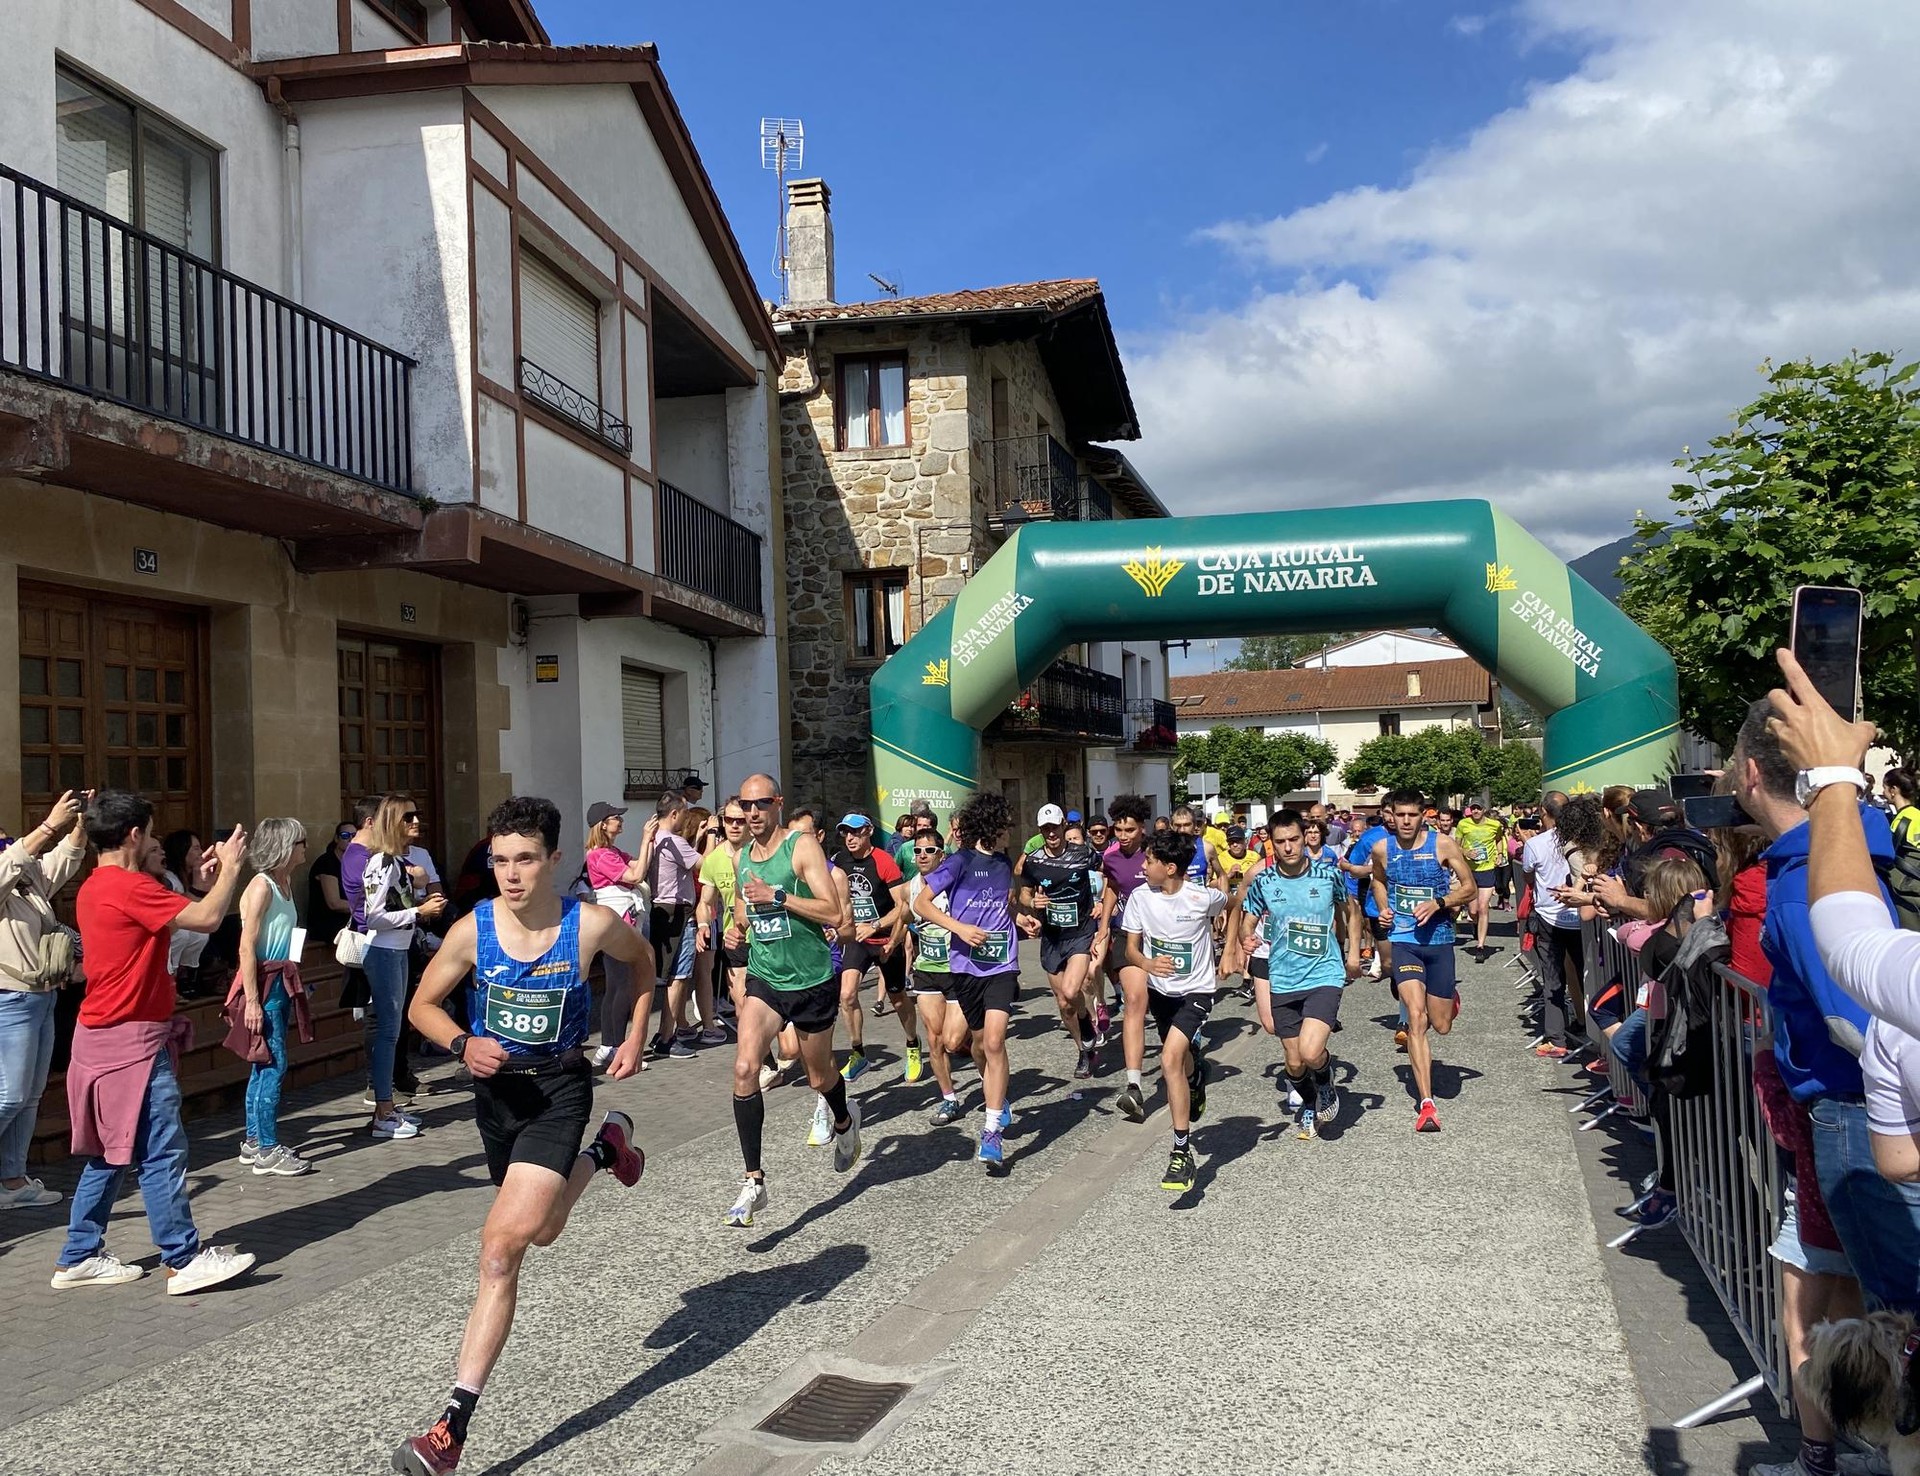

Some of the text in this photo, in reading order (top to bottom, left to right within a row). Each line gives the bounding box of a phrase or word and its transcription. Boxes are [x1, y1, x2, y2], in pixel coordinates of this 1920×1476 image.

[138, 552, 156, 571] 34
[1197, 542, 1364, 572] CAJA RURAL
[1197, 565, 1378, 595] DE NAVARRA
[404, 606, 415, 621] 32
[951, 590, 1020, 656] CAJA RURAL
[957, 594, 1035, 667] DE NAVARRA
[1521, 590, 1604, 662] CAJA RURAL
[1509, 600, 1600, 678] DE NAVARRA
[892, 788, 952, 799] CAJA RURAL
[892, 798, 905, 807] DE
[753, 917, 782, 935] 282
[1051, 913, 1073, 923] 352
[922, 944, 941, 958] 281
[1293, 935, 1321, 950] 413
[497, 1010, 549, 1034] 389
